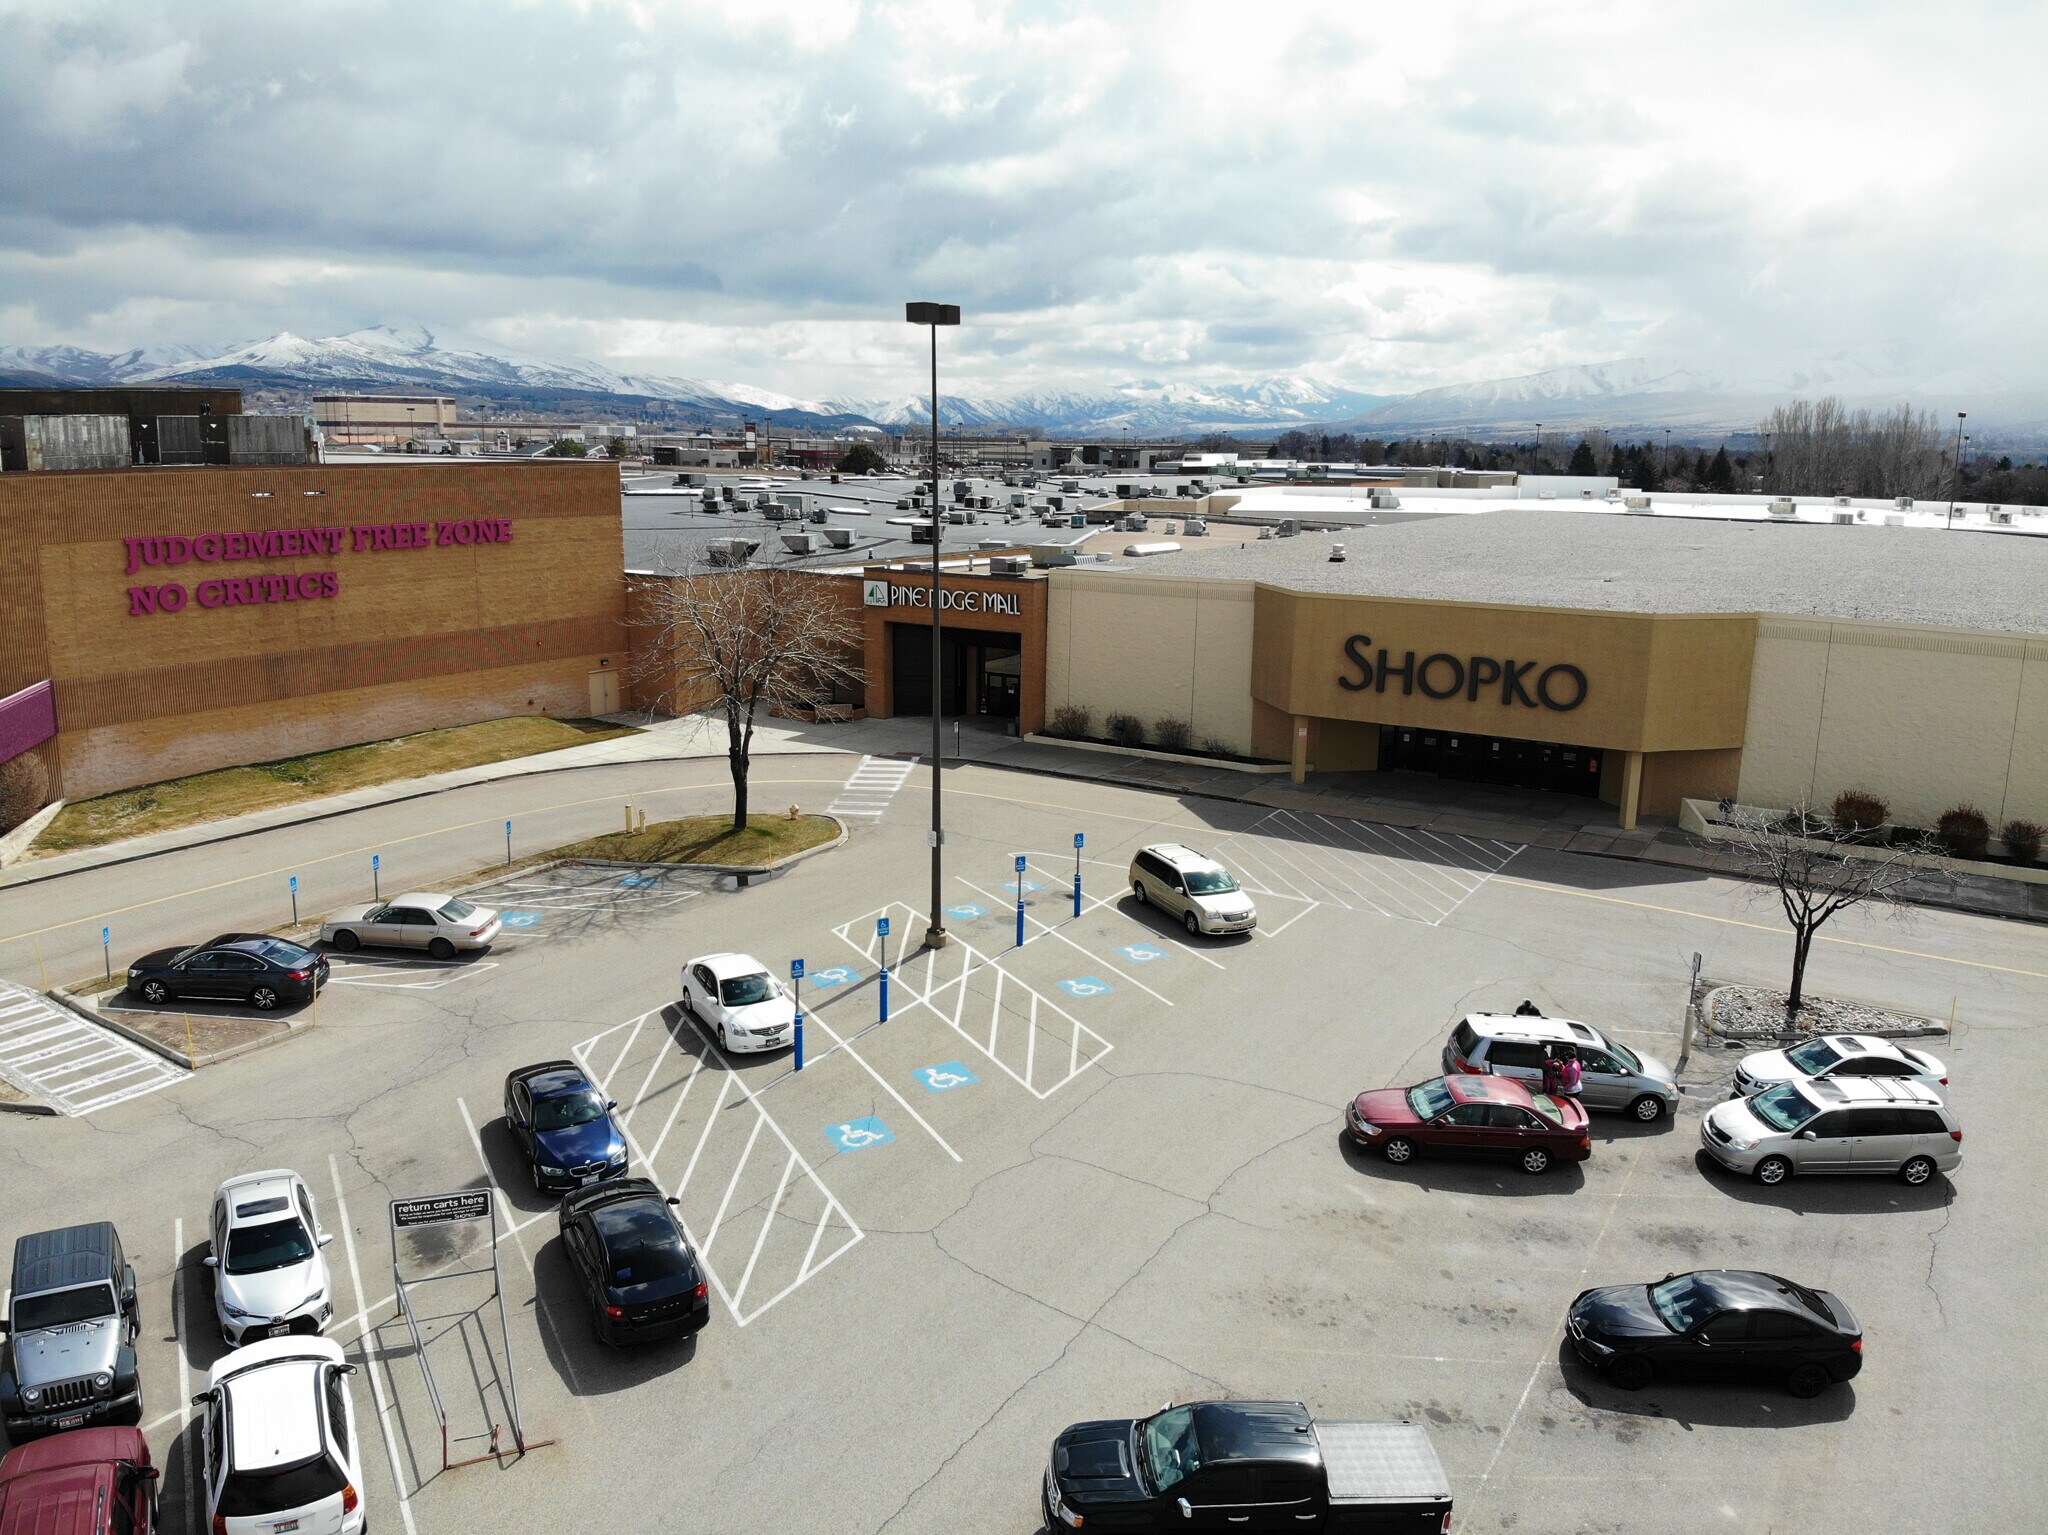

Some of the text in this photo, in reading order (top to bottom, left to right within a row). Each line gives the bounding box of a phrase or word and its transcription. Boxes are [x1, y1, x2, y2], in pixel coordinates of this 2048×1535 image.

[124, 518, 514, 575] JUDGEMENT FREE ZONE
[127, 571, 340, 616] NO CRITICS
[891, 585, 926, 607] PINE
[983, 591, 1021, 615] MALL
[1338, 634, 1588, 712] SHOPKO
[398, 1203, 431, 1213] return
[433, 1199, 459, 1210] carts
[461, 1196, 485, 1206] here
